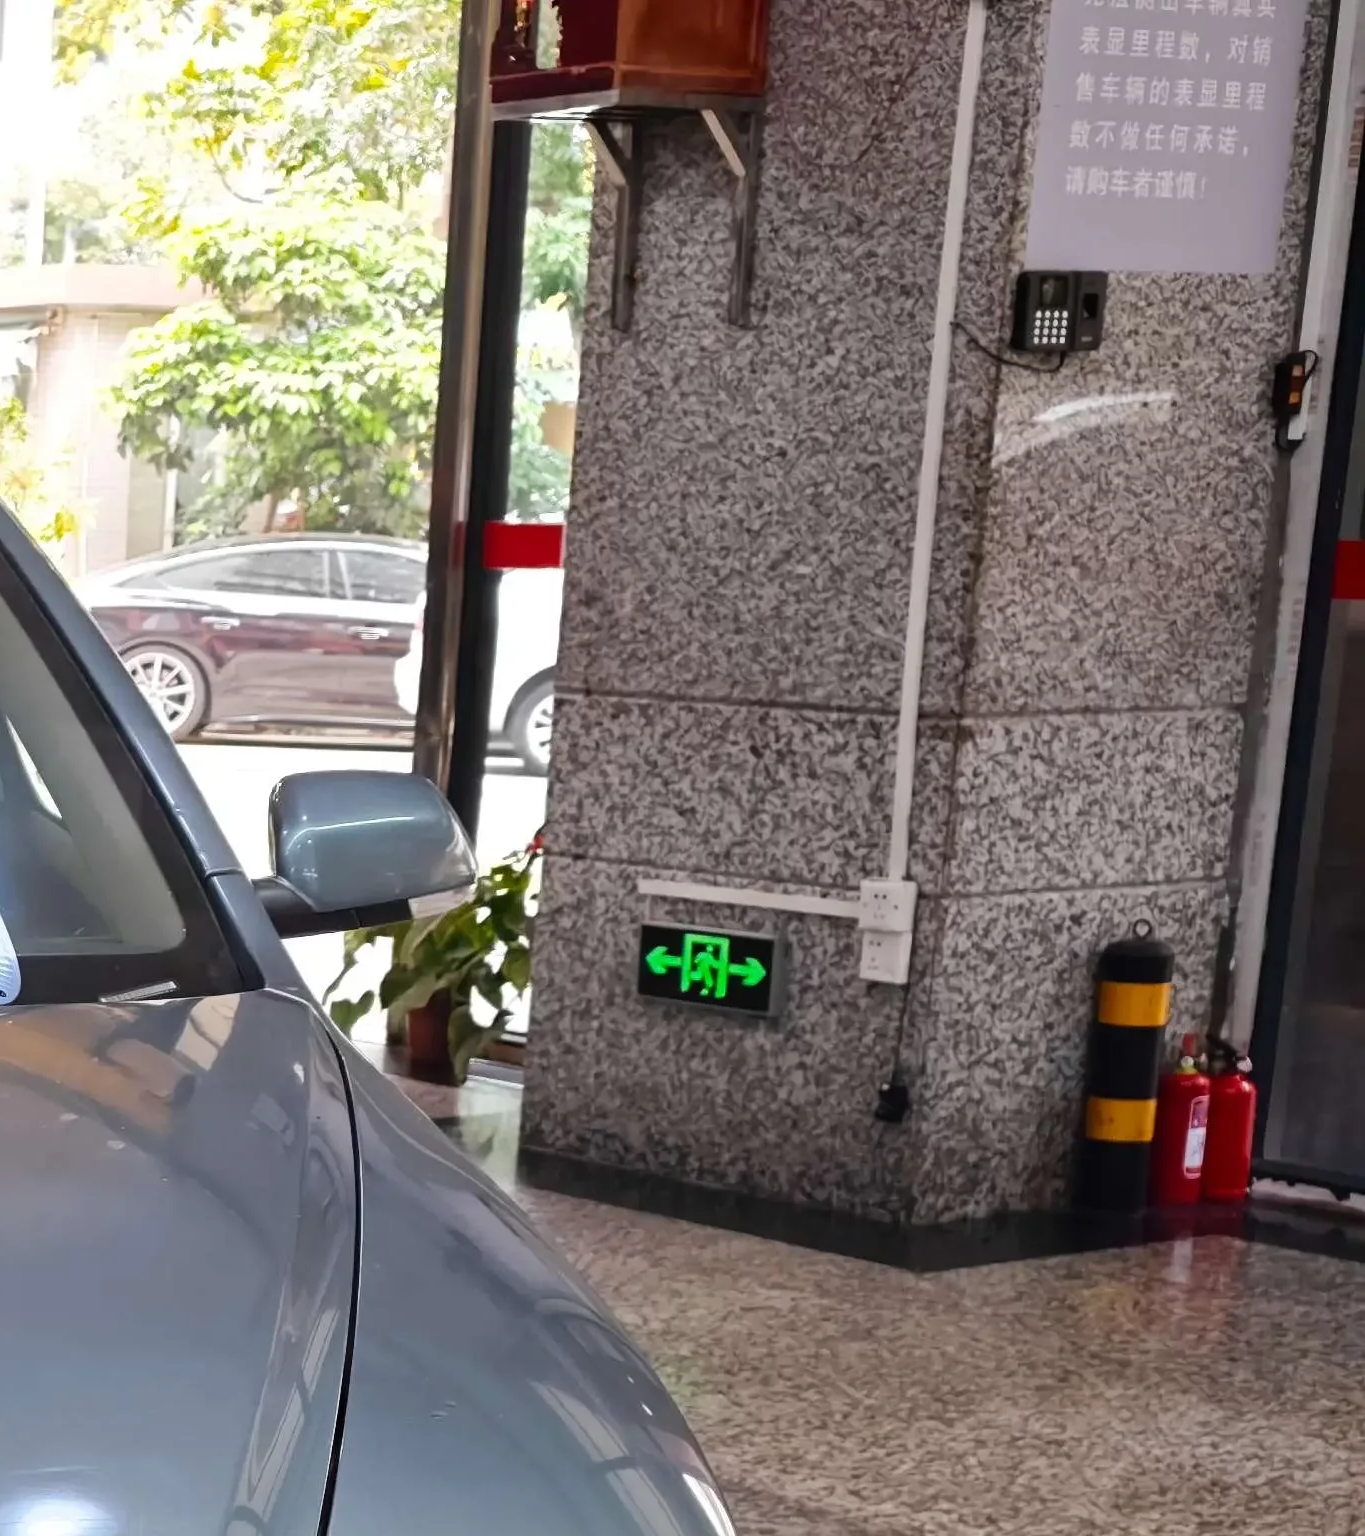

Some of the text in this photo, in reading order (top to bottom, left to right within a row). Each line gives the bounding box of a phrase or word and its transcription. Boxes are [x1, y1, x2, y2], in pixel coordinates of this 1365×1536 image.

[1075, 72, 1267, 111] 售车辆的表显里程
